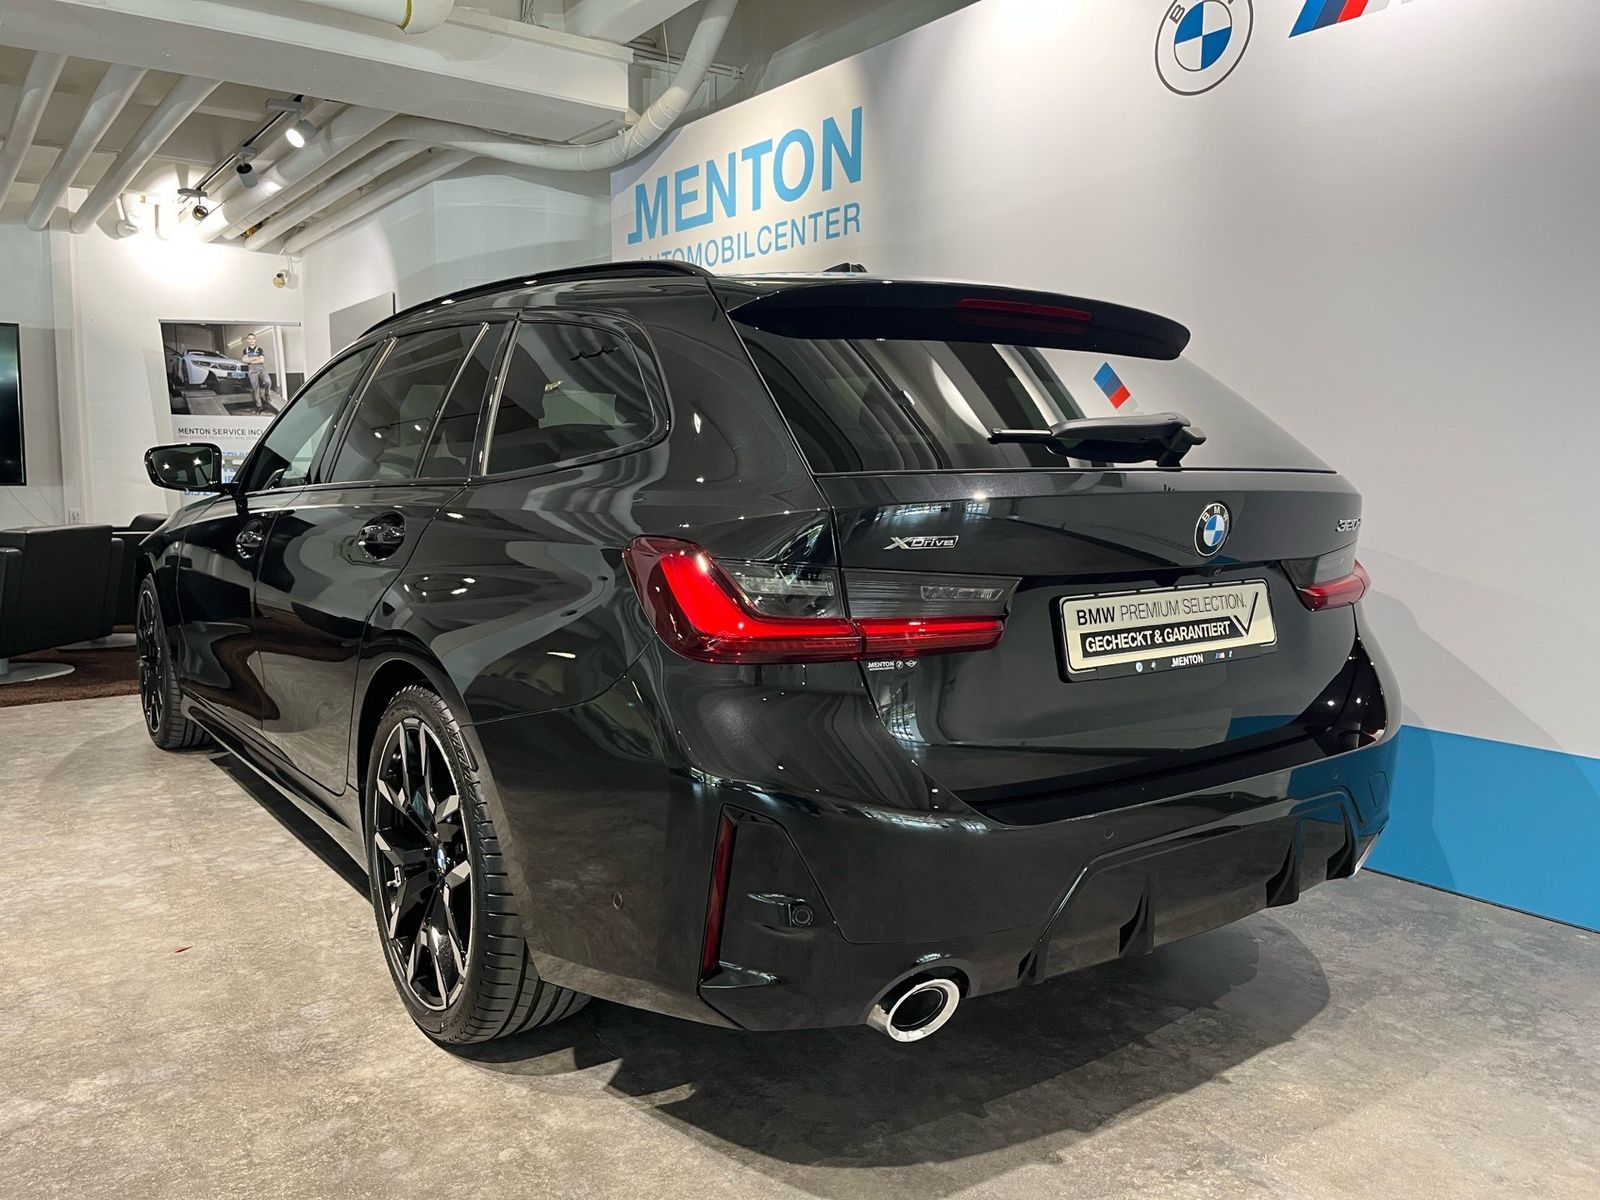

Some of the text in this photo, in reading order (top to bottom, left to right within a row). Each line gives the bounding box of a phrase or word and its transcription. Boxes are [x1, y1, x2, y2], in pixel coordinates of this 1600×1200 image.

[627, 107, 863, 245] MENTON
[640, 202, 861, 268] TOMOBILCENTER
[1077, 606, 1115, 625] BMW
[1121, 601, 1180, 621] PREMIUM
[1085, 621, 1231, 653] GECHECKT & GARANTIERT
[1171, 653, 1204, 668] MENTON
